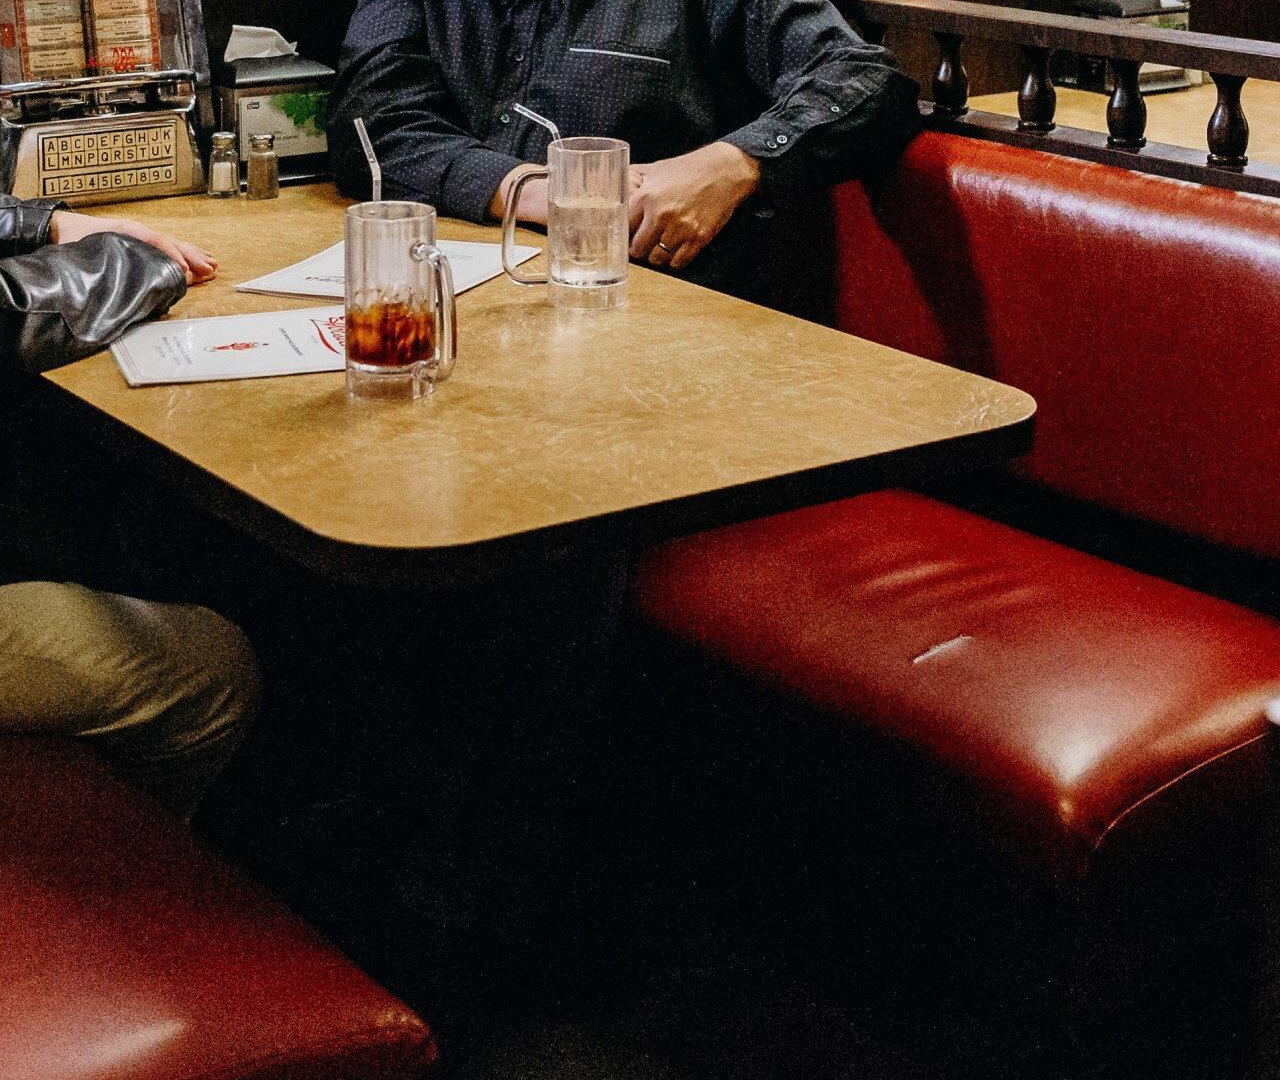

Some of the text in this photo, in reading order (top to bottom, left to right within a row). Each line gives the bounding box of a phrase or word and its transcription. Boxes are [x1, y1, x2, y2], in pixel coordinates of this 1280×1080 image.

[48, 130, 171, 152] A B C D E F G H J K
[48, 145, 171, 167] L M N P Q R S T U V
[50, 169, 172, 192] 1 2 3 4 5 6 7 8 9 0
